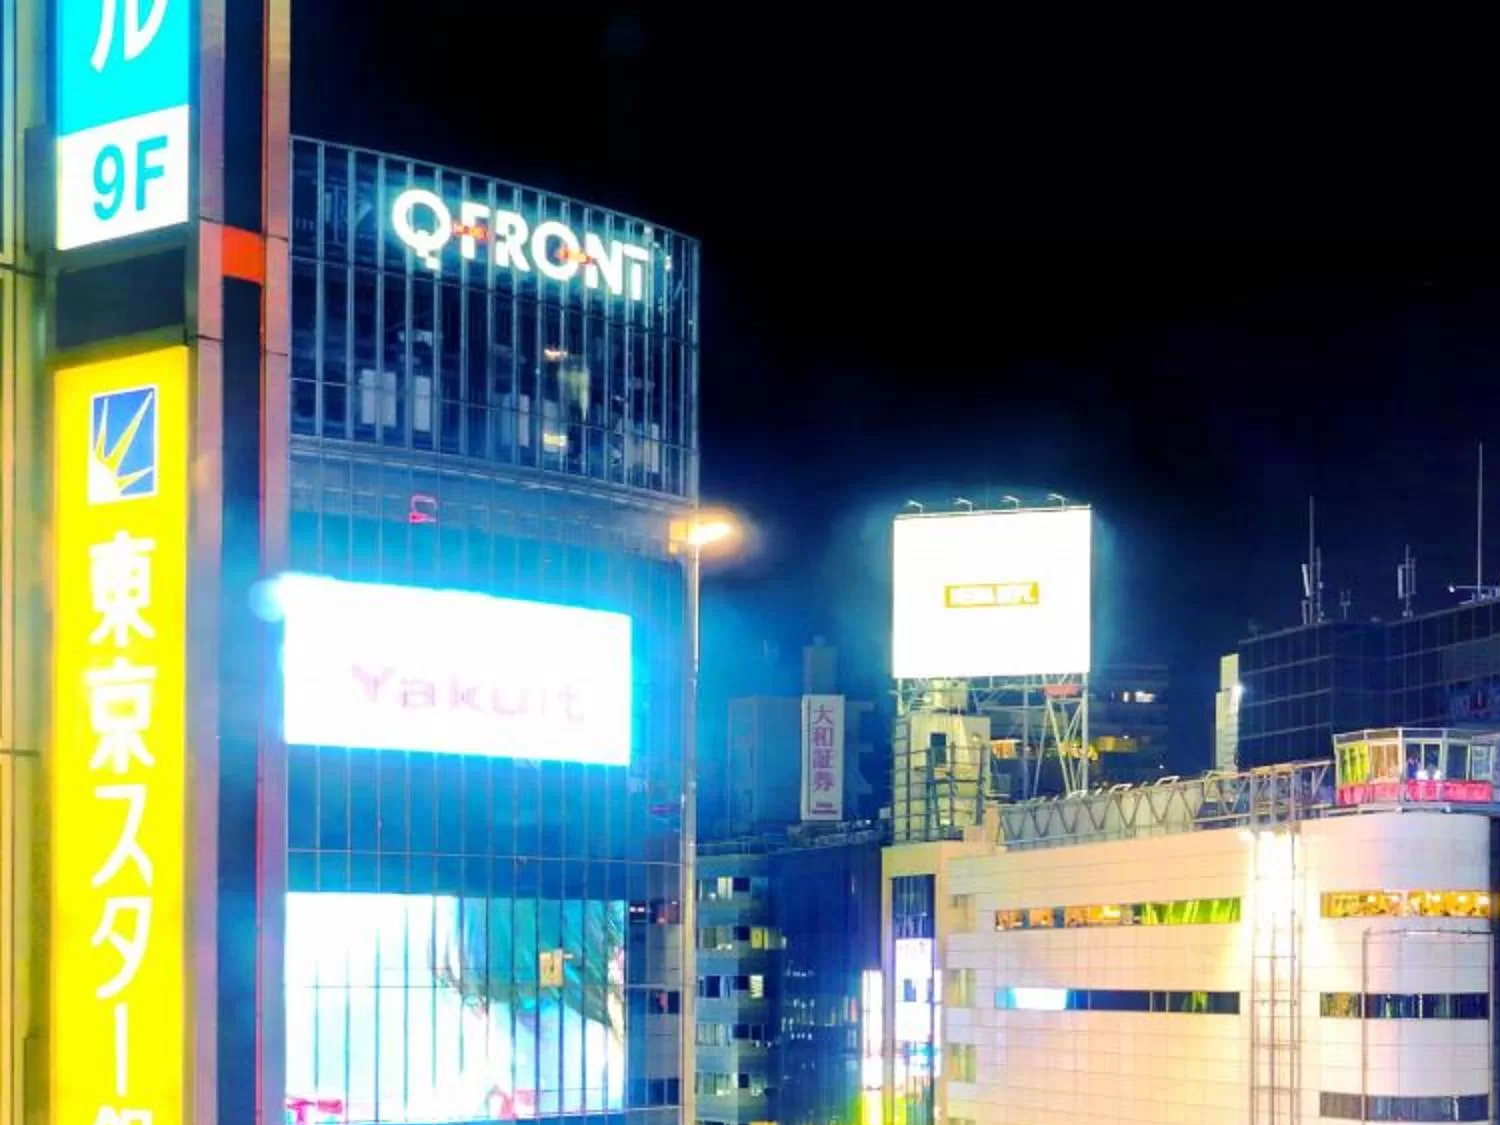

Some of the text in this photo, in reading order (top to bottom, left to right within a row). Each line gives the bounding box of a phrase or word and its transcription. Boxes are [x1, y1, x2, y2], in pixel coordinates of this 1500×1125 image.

[90, 0, 166, 72] ル
[92, 136, 168, 221] 9F
[393, 189, 651, 301] QFRONT
[352, 664, 588, 724] Yakult
